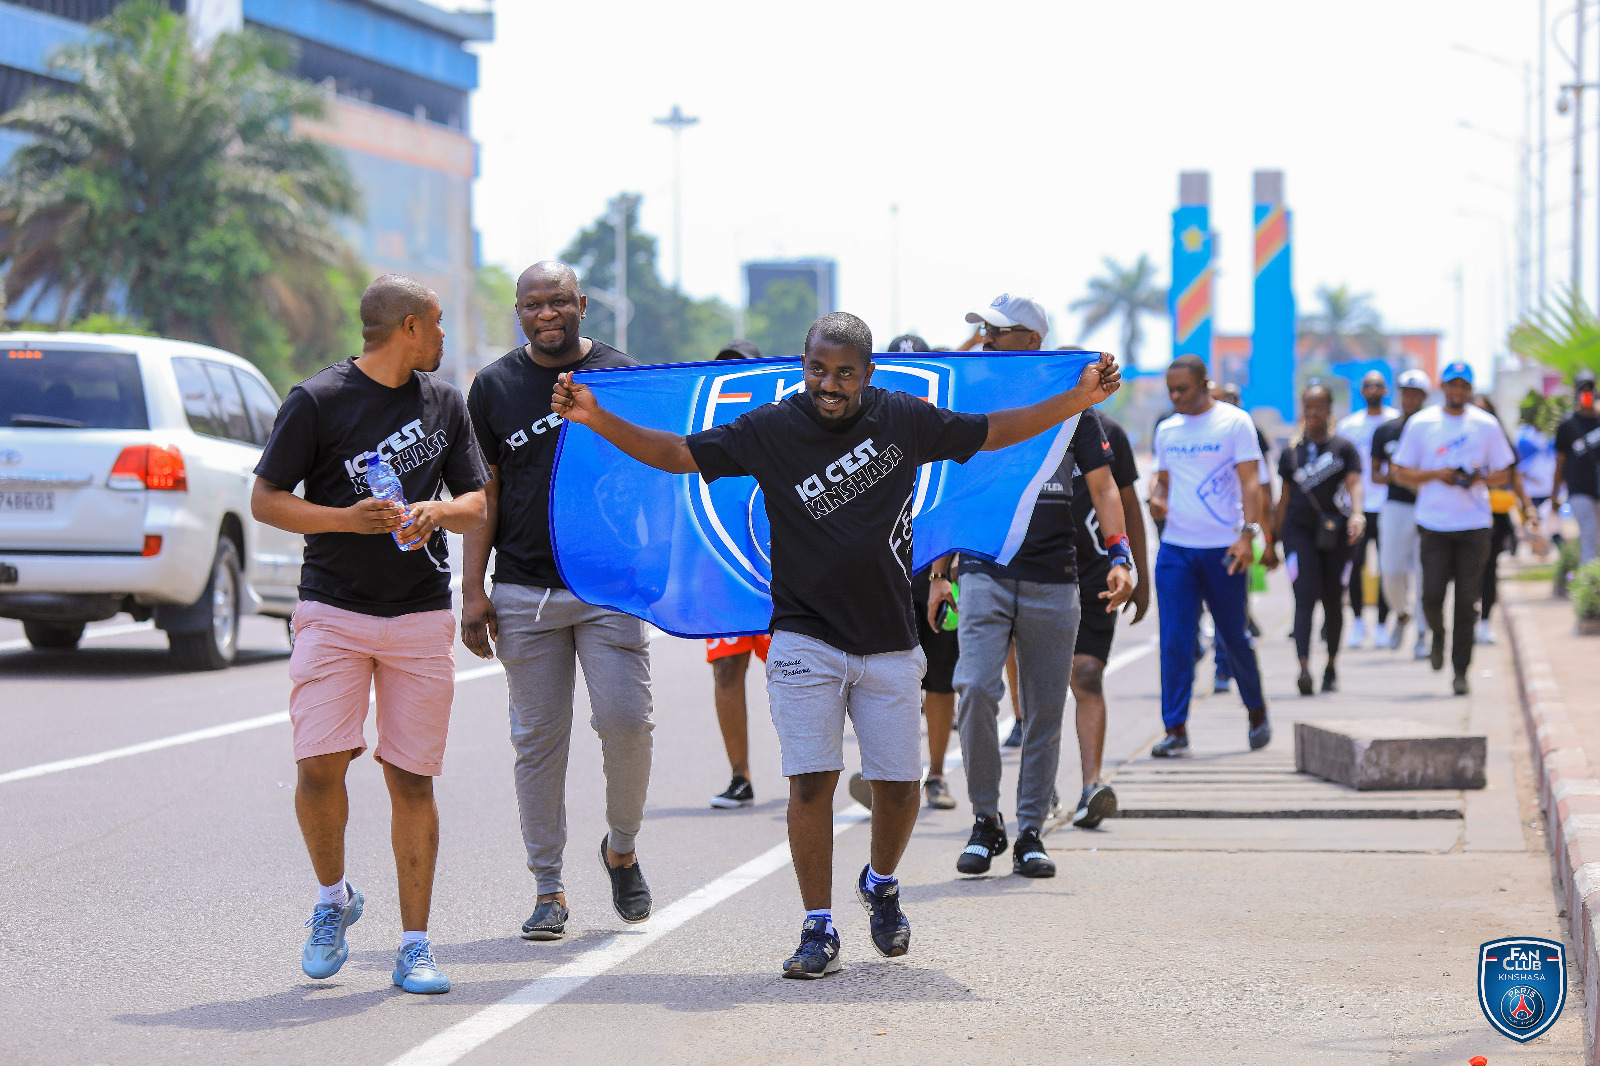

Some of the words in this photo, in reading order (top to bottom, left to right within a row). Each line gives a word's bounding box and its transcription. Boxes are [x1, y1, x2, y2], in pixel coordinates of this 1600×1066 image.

[350, 429, 449, 495] KSHASA
[376, 418, 426, 461] C'EST
[505, 429, 529, 451] ICI
[531, 411, 565, 435] C'E
[794, 472, 826, 502] ICI
[824, 437, 879, 483] C'EST
[804, 443, 903, 520] KINSHASA
